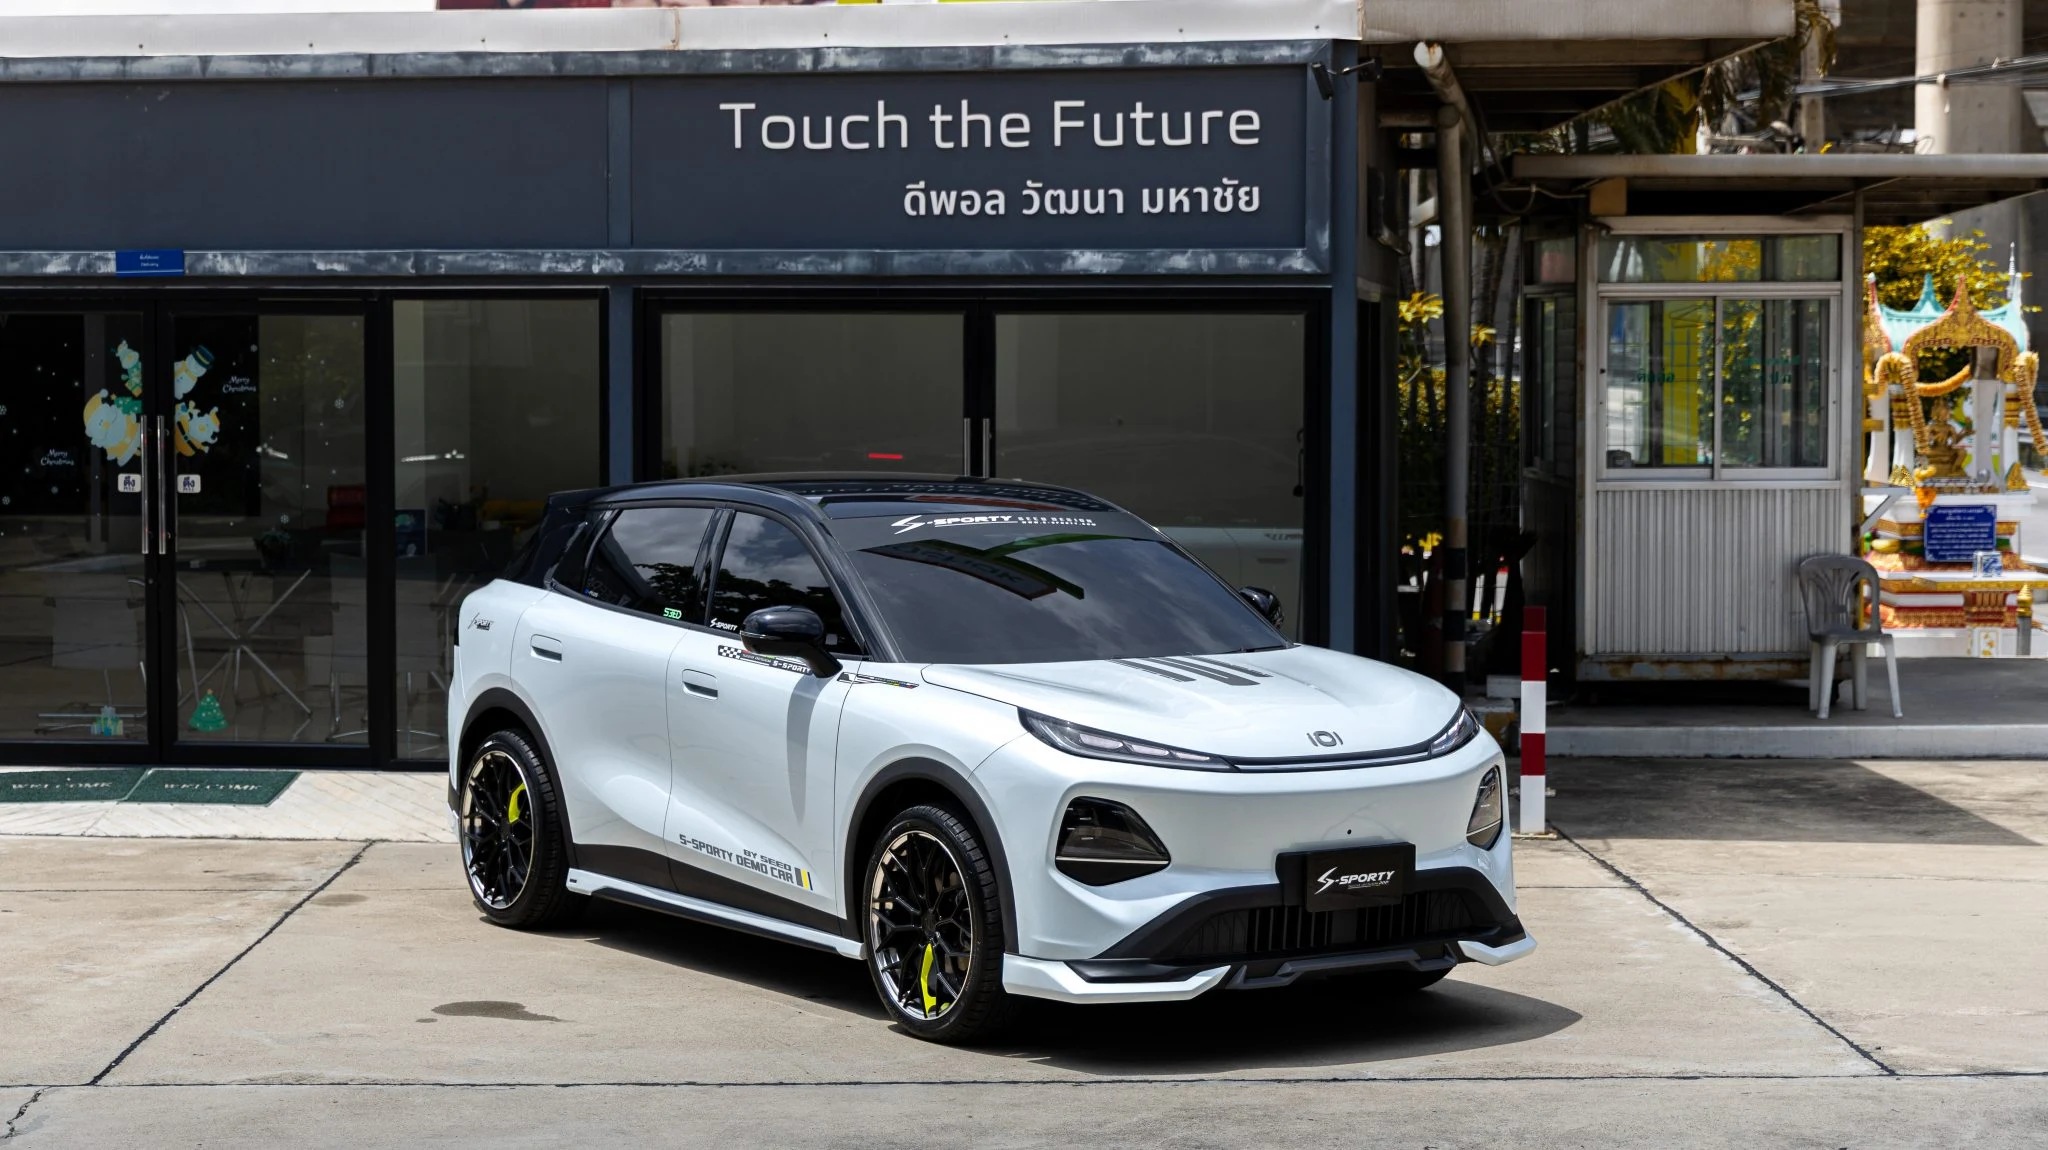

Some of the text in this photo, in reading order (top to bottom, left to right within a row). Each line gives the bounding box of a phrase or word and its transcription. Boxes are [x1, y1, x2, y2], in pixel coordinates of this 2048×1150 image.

[719, 99, 1261, 150] Touch the Future
[903, 177, 1261, 216] ดีพอล วัฒนา มหาชัย
[890, 514, 1013, 535] S-SPORTY
[772, 660, 811, 674] S-SPORTY
[679, 833, 794, 884] S-SPORTY DEMO CAR
[743, 848, 792, 872] BY SEED
[1314, 866, 1396, 895] S-SPORTY
